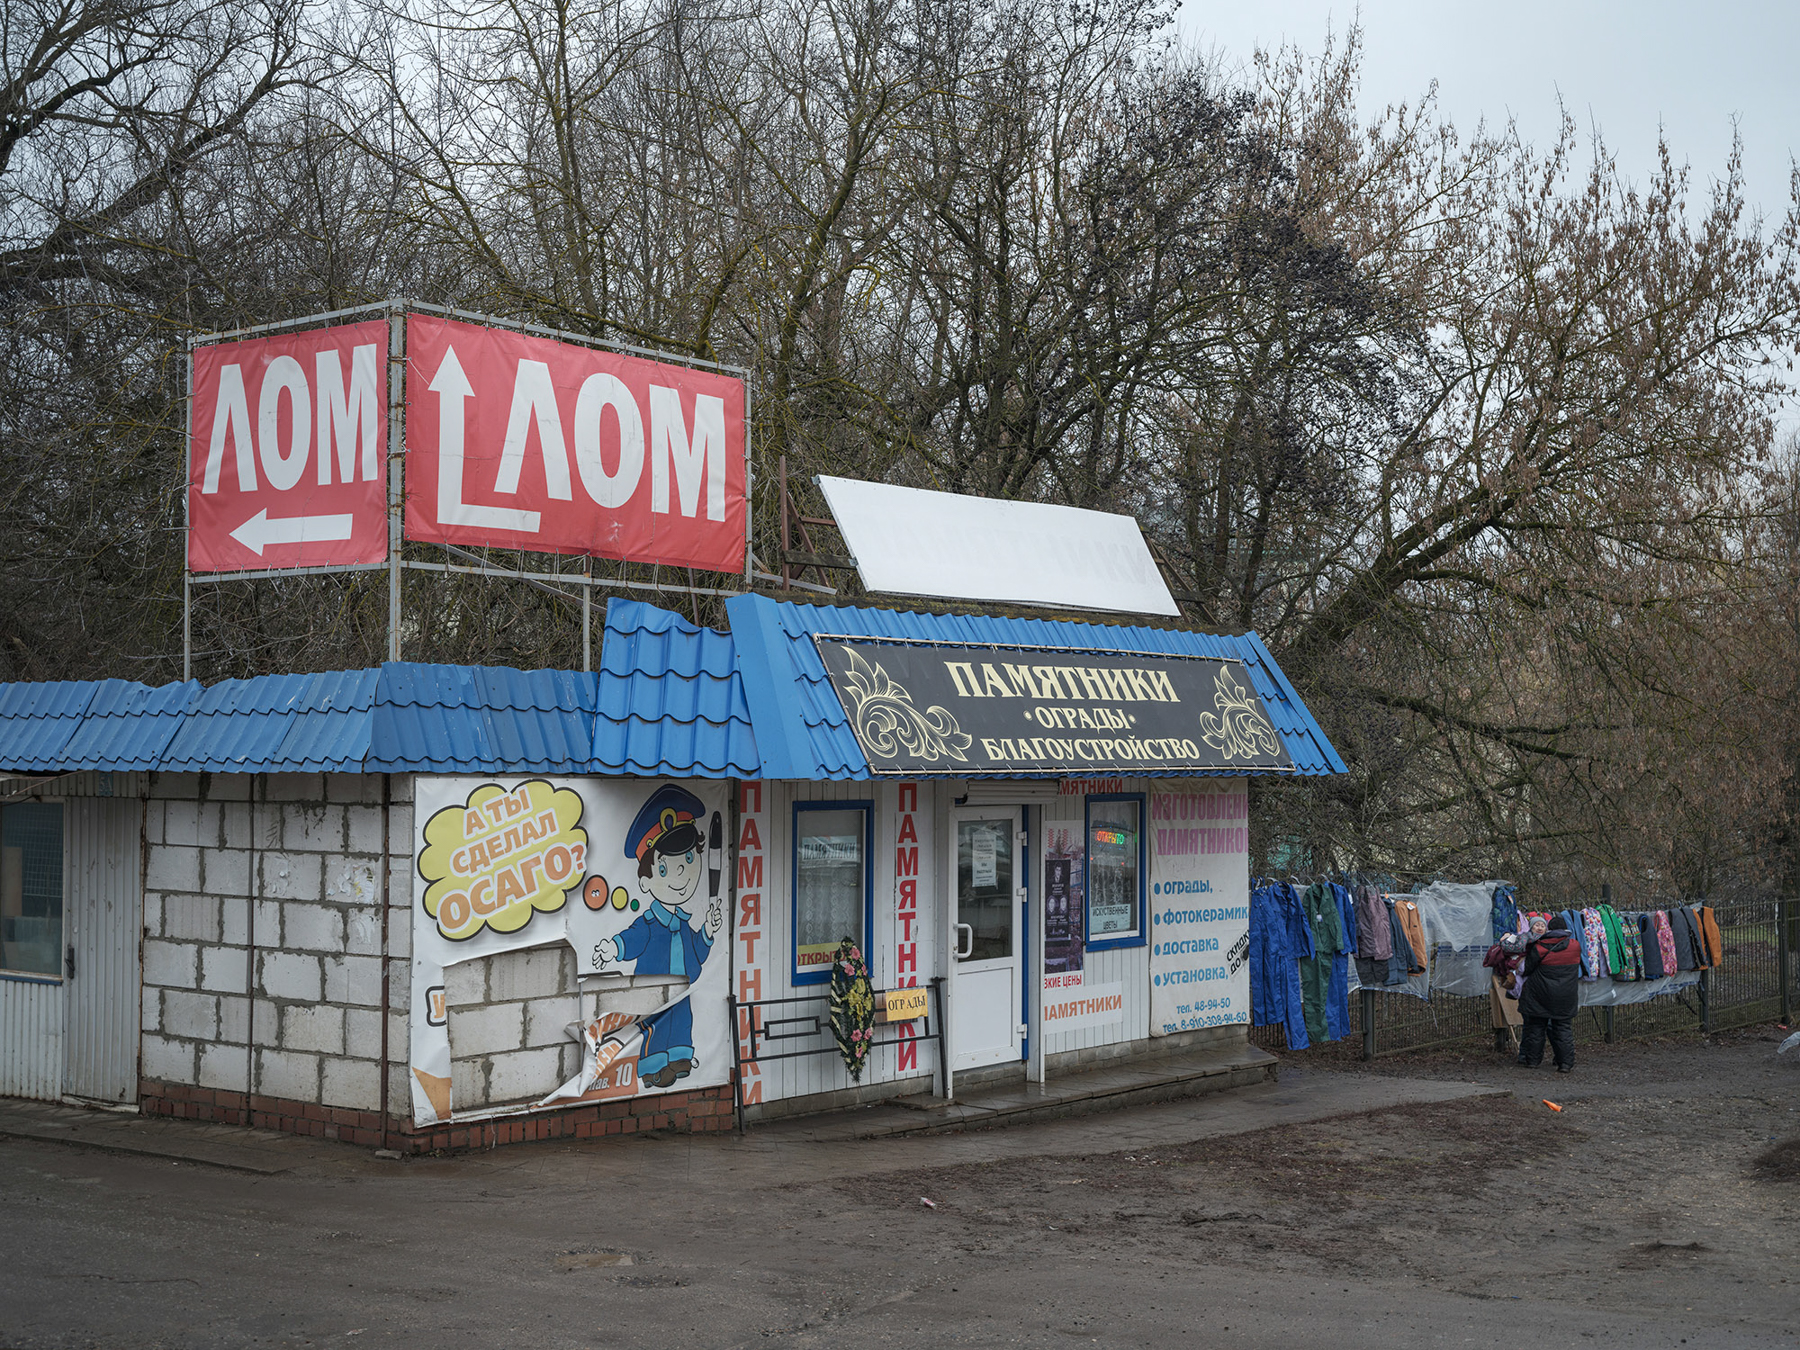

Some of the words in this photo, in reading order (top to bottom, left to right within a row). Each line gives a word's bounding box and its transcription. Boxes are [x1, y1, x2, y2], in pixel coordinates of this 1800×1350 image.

[202, 343, 378, 494] ЛОМ
[494, 358, 725, 522] ЛОМ
[944, 661, 1181, 702] ПАМЯТНИКИ
[1034, 706, 1132, 734] ОГРАДЫ
[980, 735, 1200, 761] БЛАГОУСТРОЙСТВО
[1059, 778, 1123, 796] МЯТНИКИ
[465, 810, 486, 836] А
[485, 788, 530, 823] ТЫ
[452, 811, 557, 874] СДЕЛАЛ
[1096, 830, 1125, 845] ОТКРЫТО
[439, 844, 585, 930] ОСАГО?
[1163, 907, 1249, 925] фотокерамик
[738, 781, 762, 1106] ПАМЯТНИКИ
[1226, 929, 1250, 962] СКИДК
[1062, 974, 1083, 988] ЦЕНЫ
[888, 996, 926, 1011] ОГРАДЫ
[1194, 997, 1231, 1012] 48-94-50
[1180, 1011, 1248, 1030] 8-910-308-94-60
[615, 1062, 634, 1088] 10
